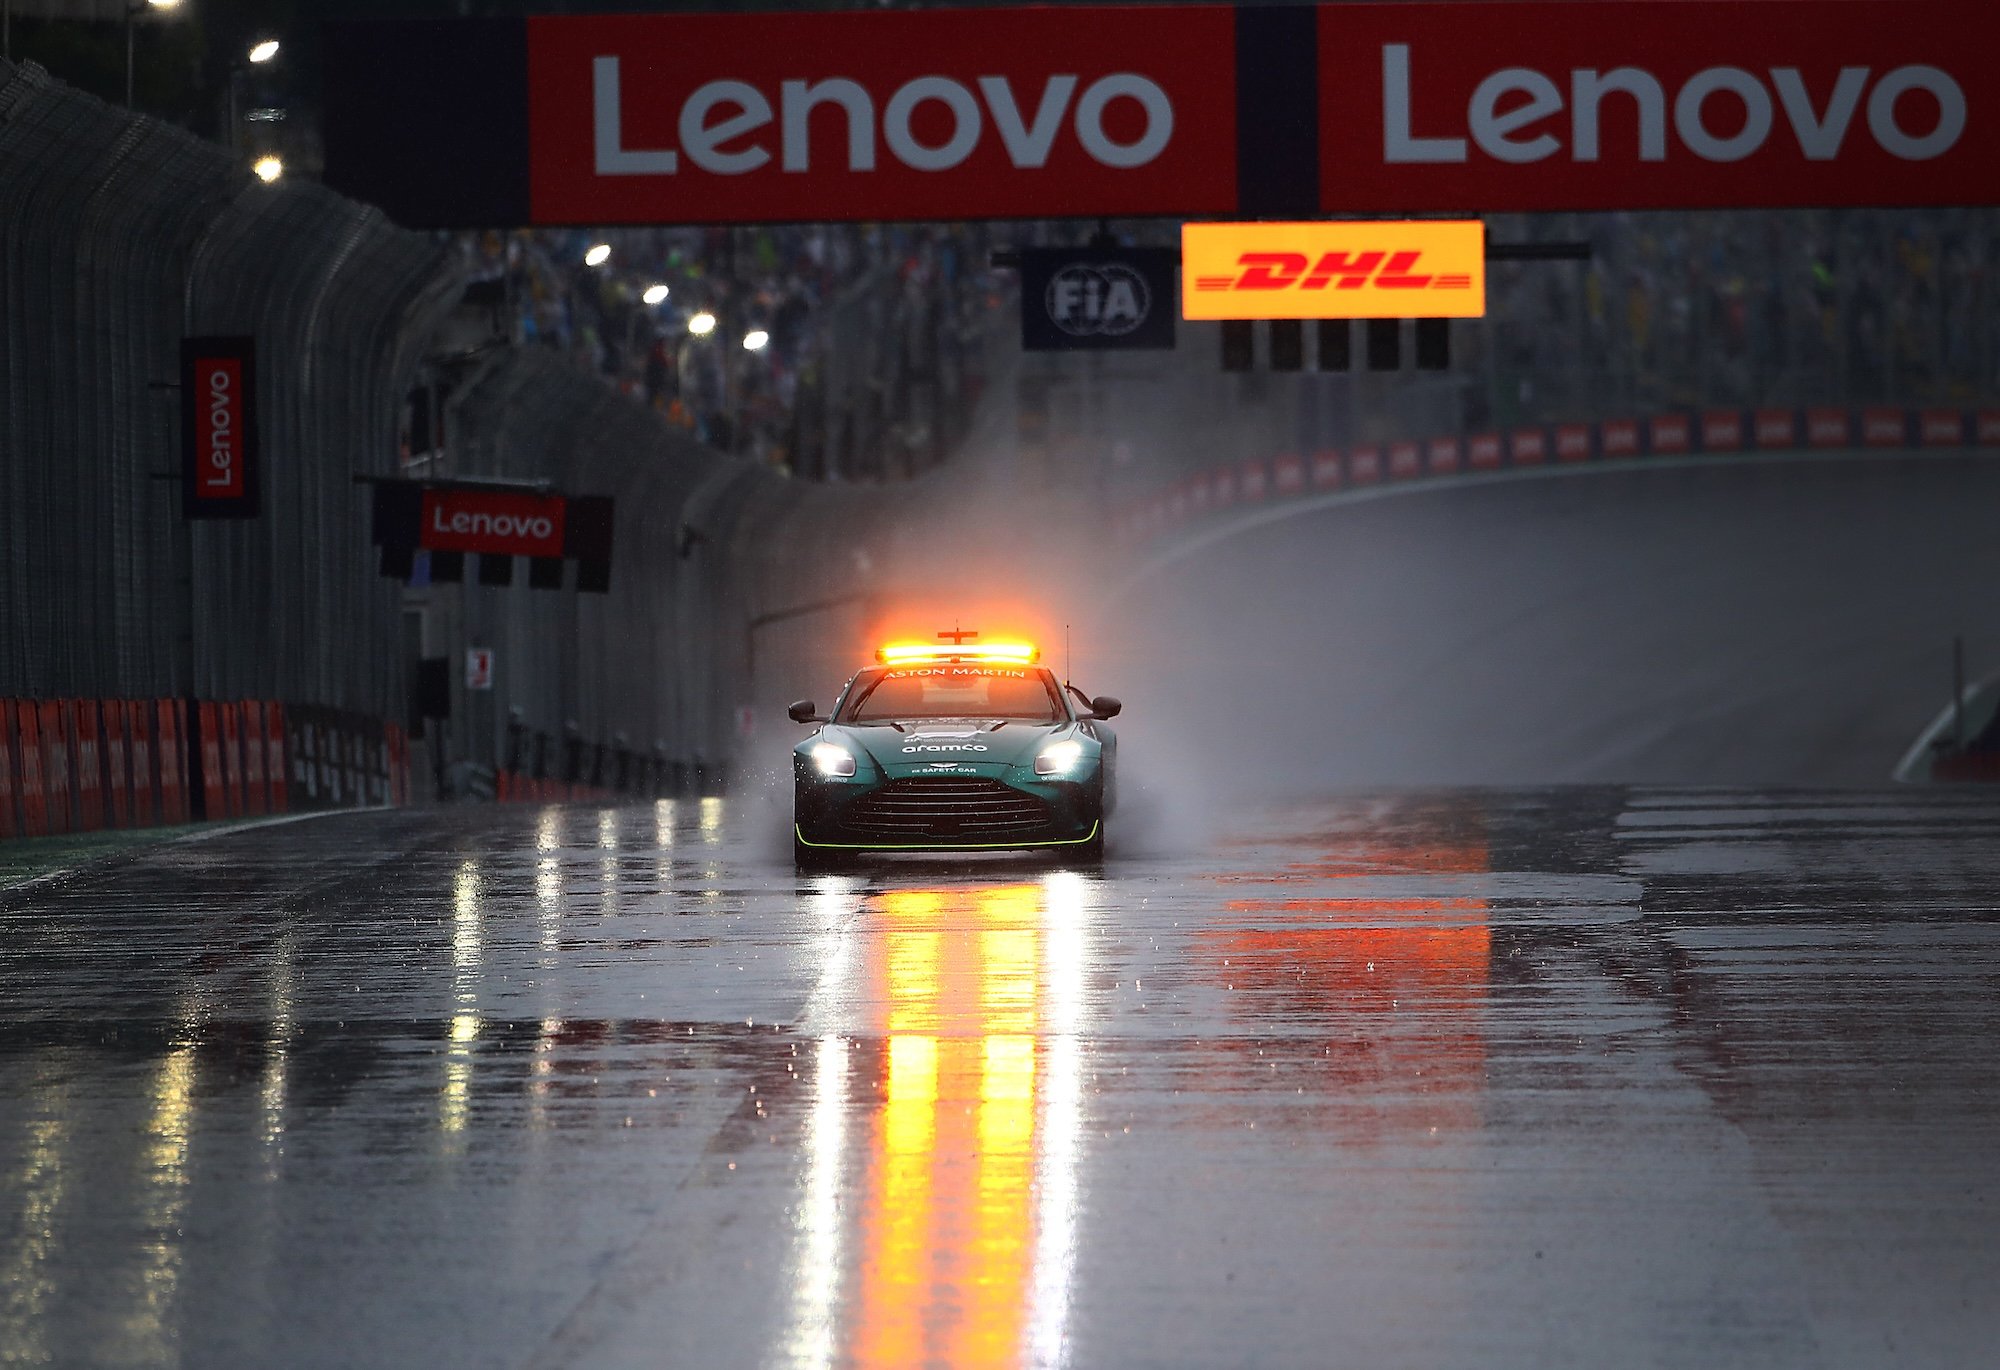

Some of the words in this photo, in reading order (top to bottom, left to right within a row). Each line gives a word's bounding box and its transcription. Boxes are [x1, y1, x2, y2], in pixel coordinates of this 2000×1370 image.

[593, 54, 1174, 178] Lenovo
[1382, 42, 1967, 165] Lenovo
[1234, 250, 1435, 291] DHL
[206, 370, 231, 488] Lenovo
[434, 505, 553, 539] Lenovo
[883, 668, 947, 679] ASTON
[952, 668, 1026, 678] MARTIN
[901, 743, 988, 753] aramco
